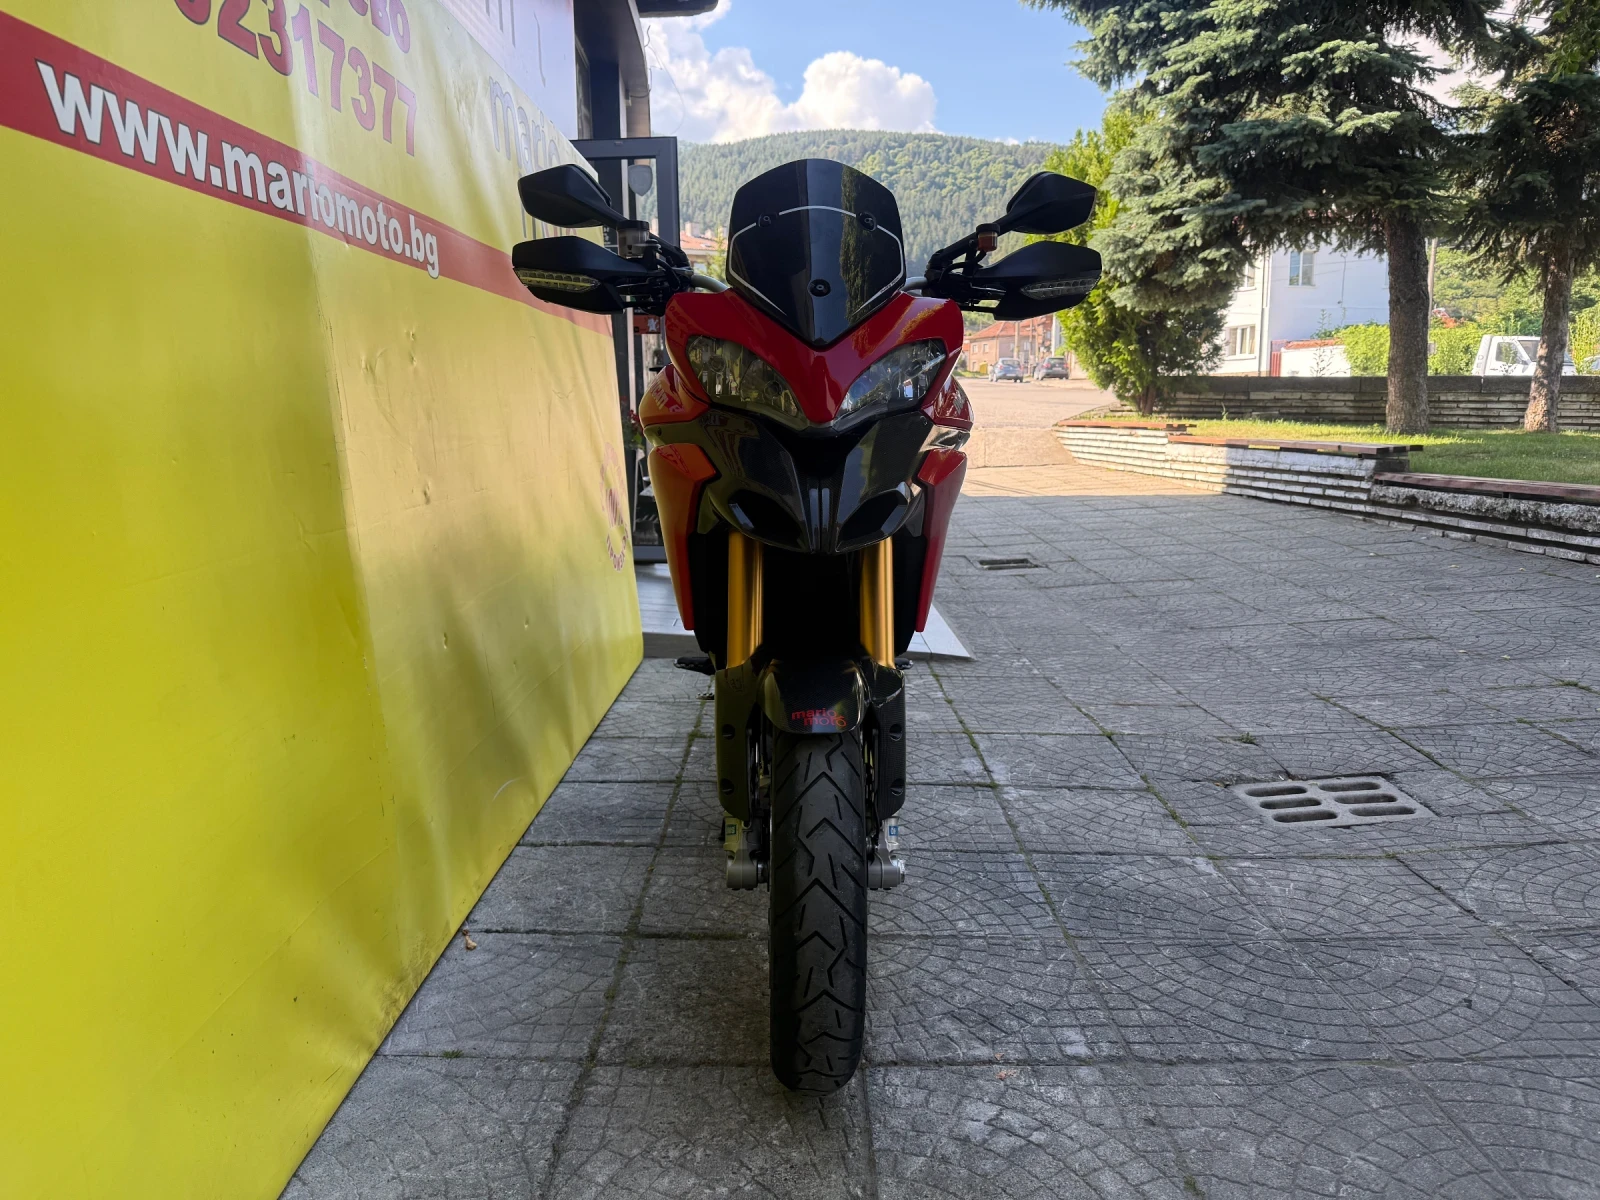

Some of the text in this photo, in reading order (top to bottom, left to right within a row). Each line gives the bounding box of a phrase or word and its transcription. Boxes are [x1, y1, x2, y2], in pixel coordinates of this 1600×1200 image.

[36, 59, 439, 279] www.mariomoto.bg
[792, 708, 837, 720] mario
[804, 716, 847, 727] moto
